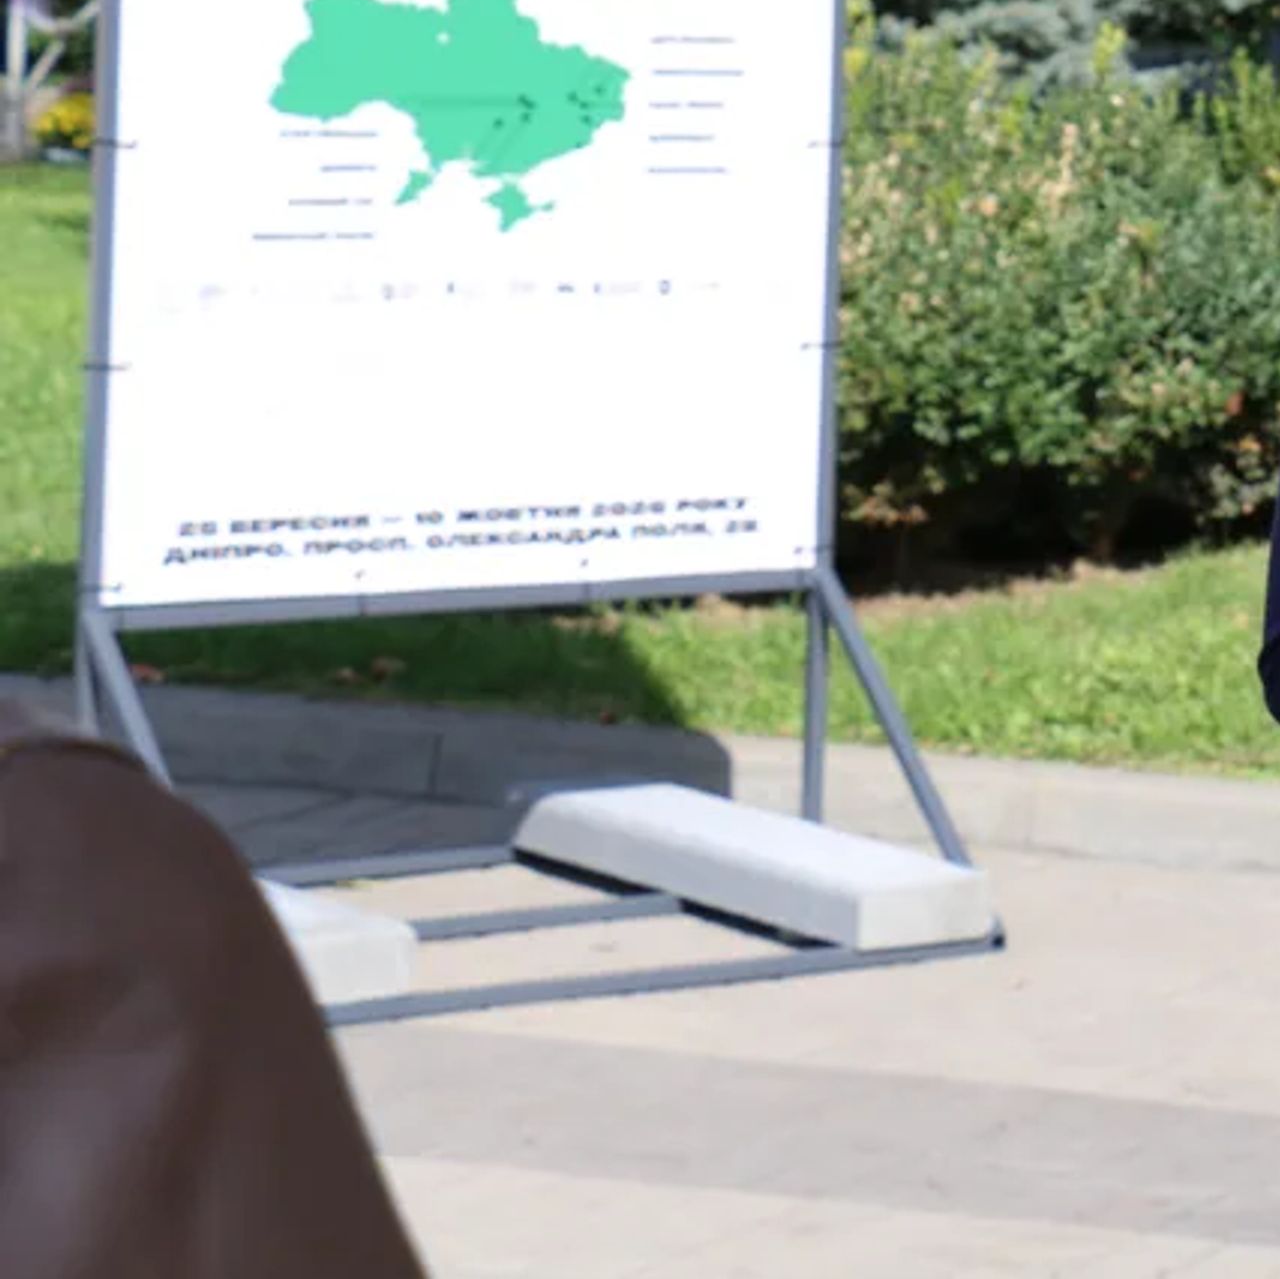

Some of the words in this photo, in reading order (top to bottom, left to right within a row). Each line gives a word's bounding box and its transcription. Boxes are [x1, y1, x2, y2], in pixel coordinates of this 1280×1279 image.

[229, 514, 370, 534] ВЕРЕСНЯ
[456, 505, 581, 522] ЖОВТНЯ
[676, 498, 746, 512] РОКУ
[426, 526, 621, 549] ОЛЕКСАНДРА
